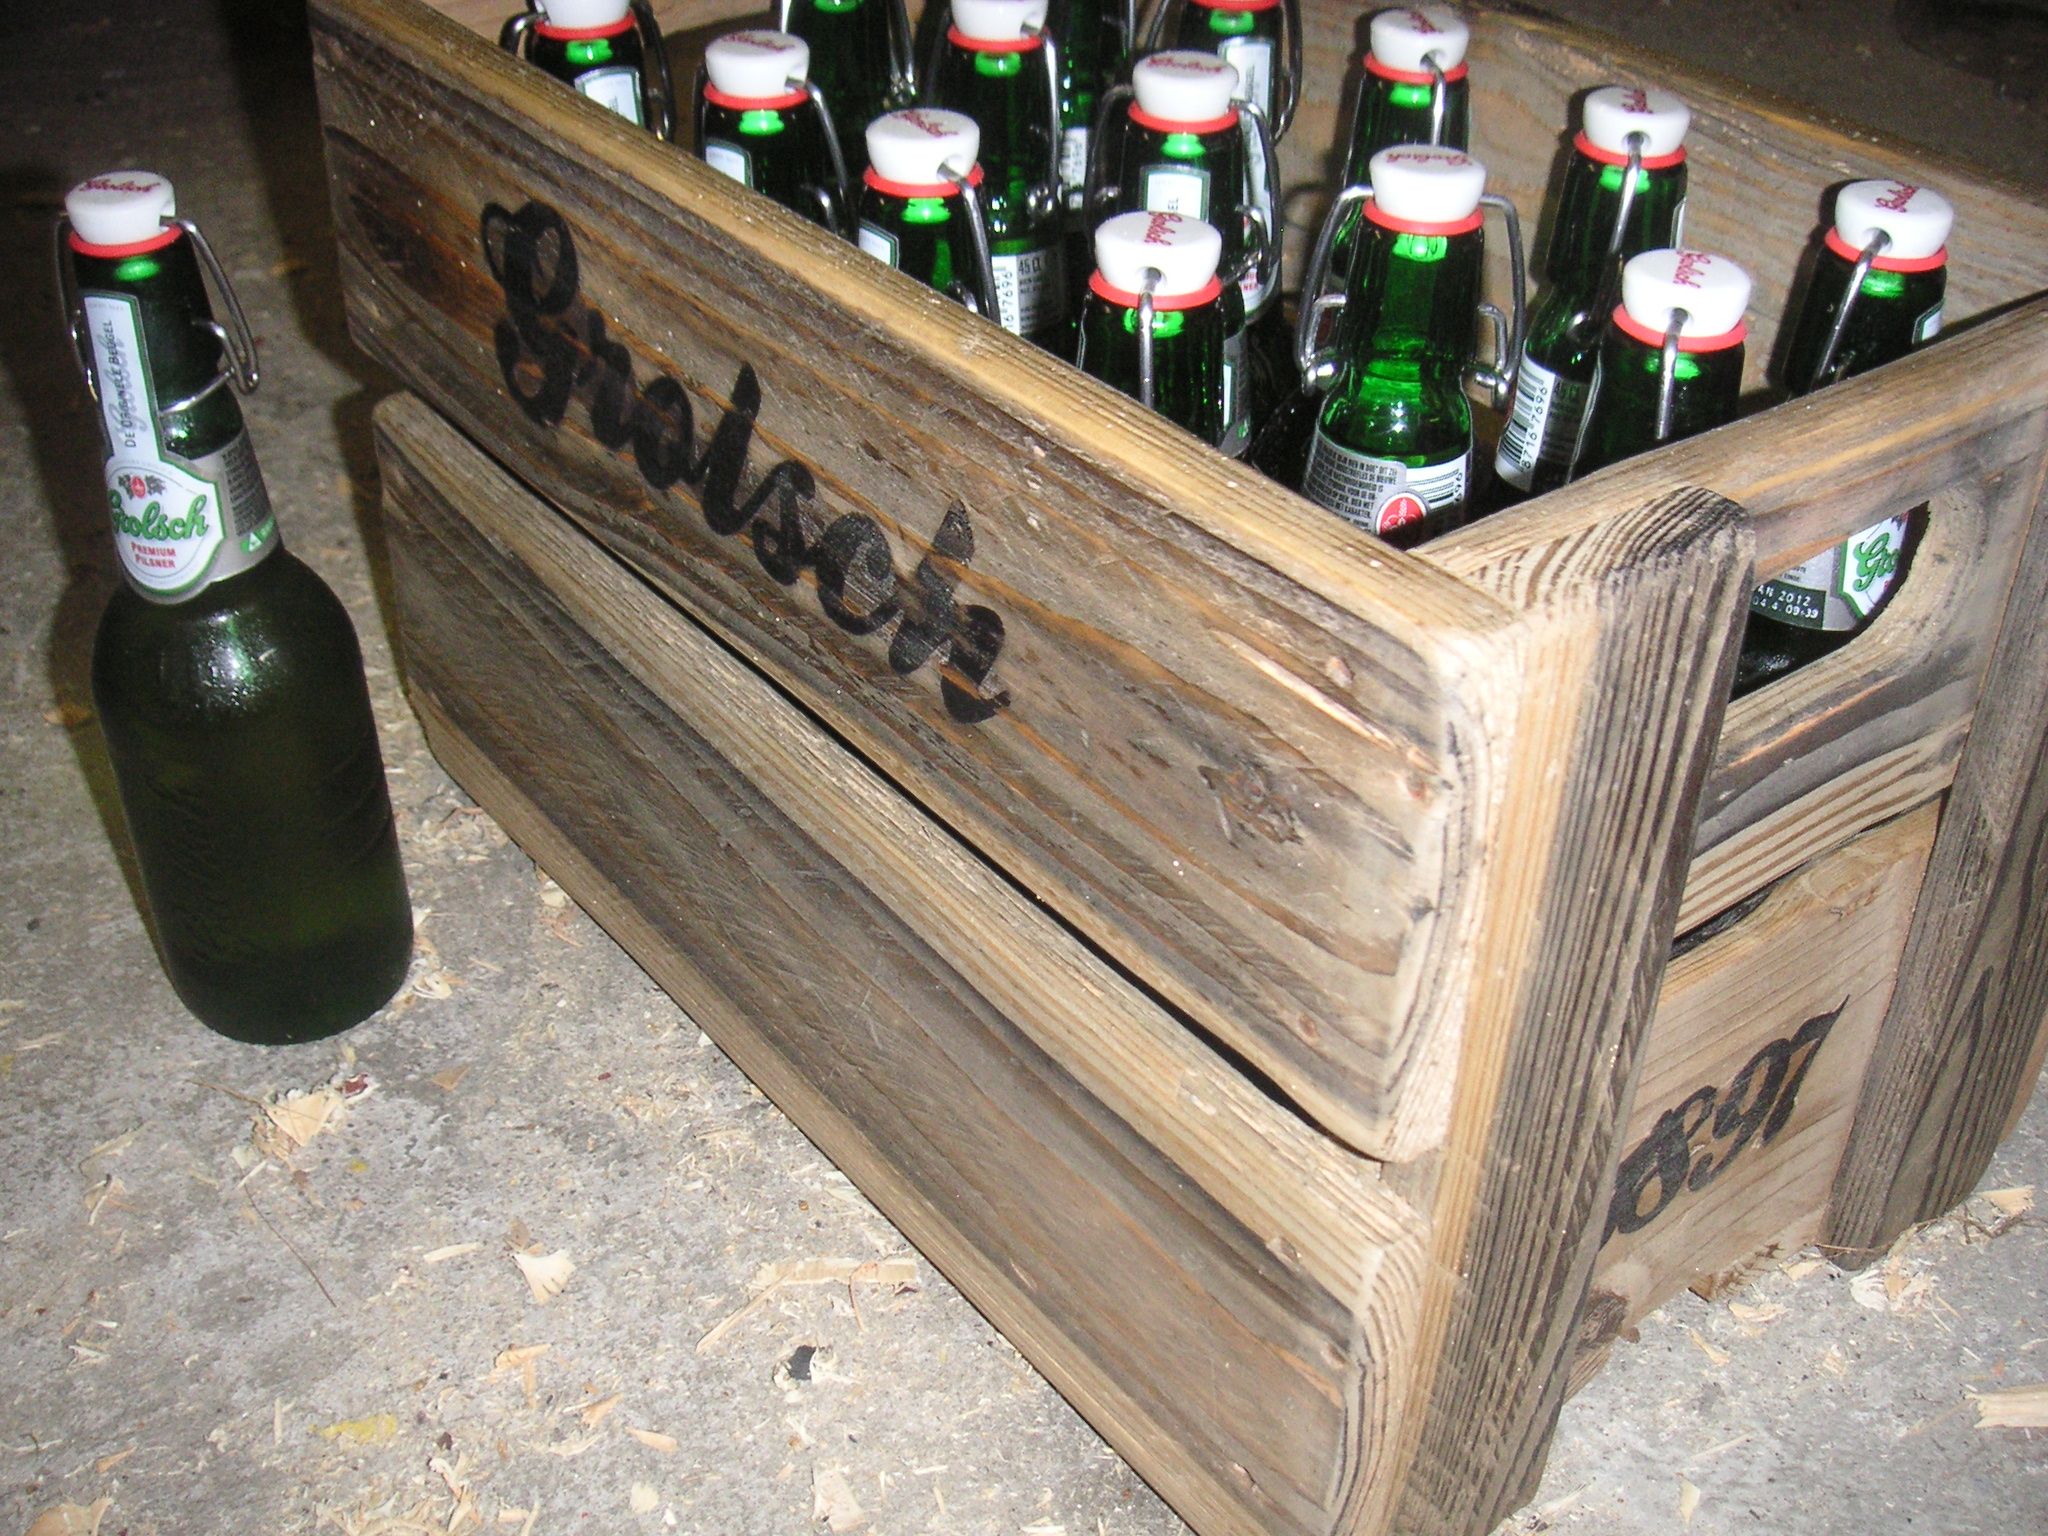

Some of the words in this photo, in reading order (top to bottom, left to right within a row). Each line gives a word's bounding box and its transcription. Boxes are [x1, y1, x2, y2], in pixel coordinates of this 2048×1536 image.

[124, 432, 137, 448] DE
[130, 541, 177, 557] PREMIUM
[134, 553, 176, 568] PILSNER
[1778, 590, 1811, 607] 2012
